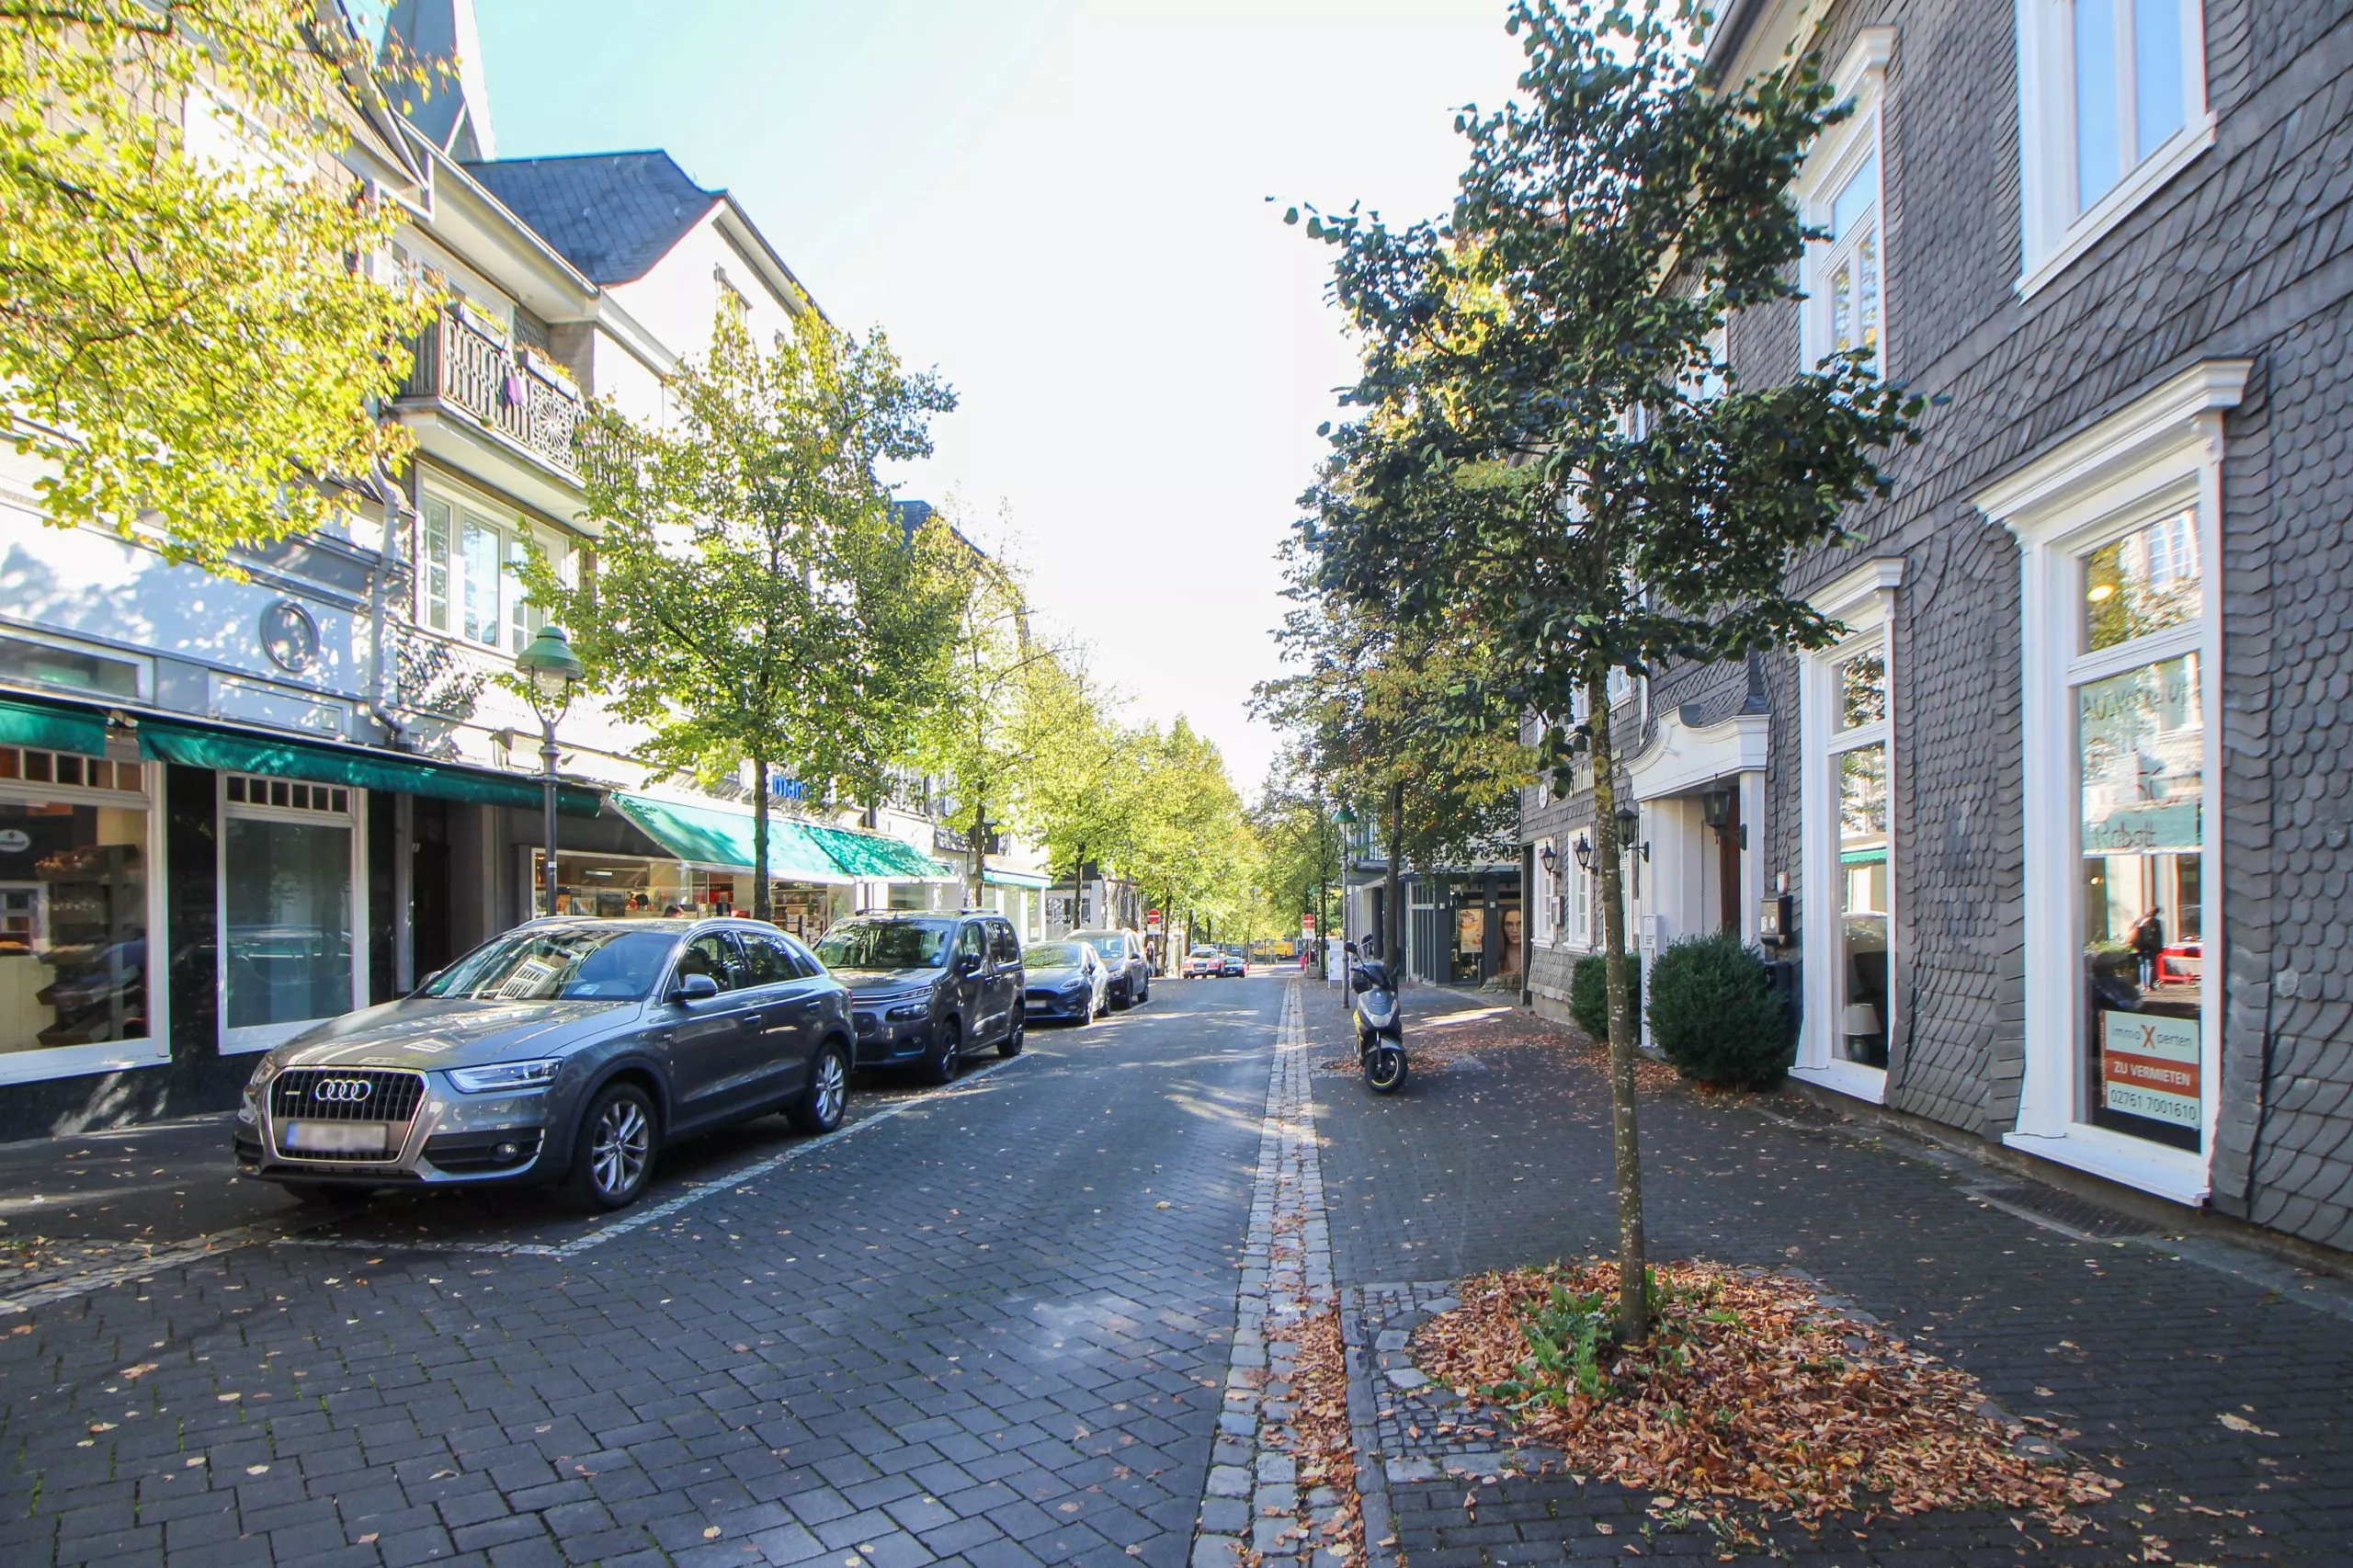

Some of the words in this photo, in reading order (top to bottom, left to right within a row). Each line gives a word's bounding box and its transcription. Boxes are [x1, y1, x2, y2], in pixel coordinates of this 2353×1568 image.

[2111, 1025, 2192, 1050] immoXperten
[2114, 1061, 2129, 1074] ZU
[2131, 1063, 2191, 1086] VERMIETEN
[2110, 1089, 2143, 1108] 02761
[2147, 1096, 2197, 1120] 7001610
